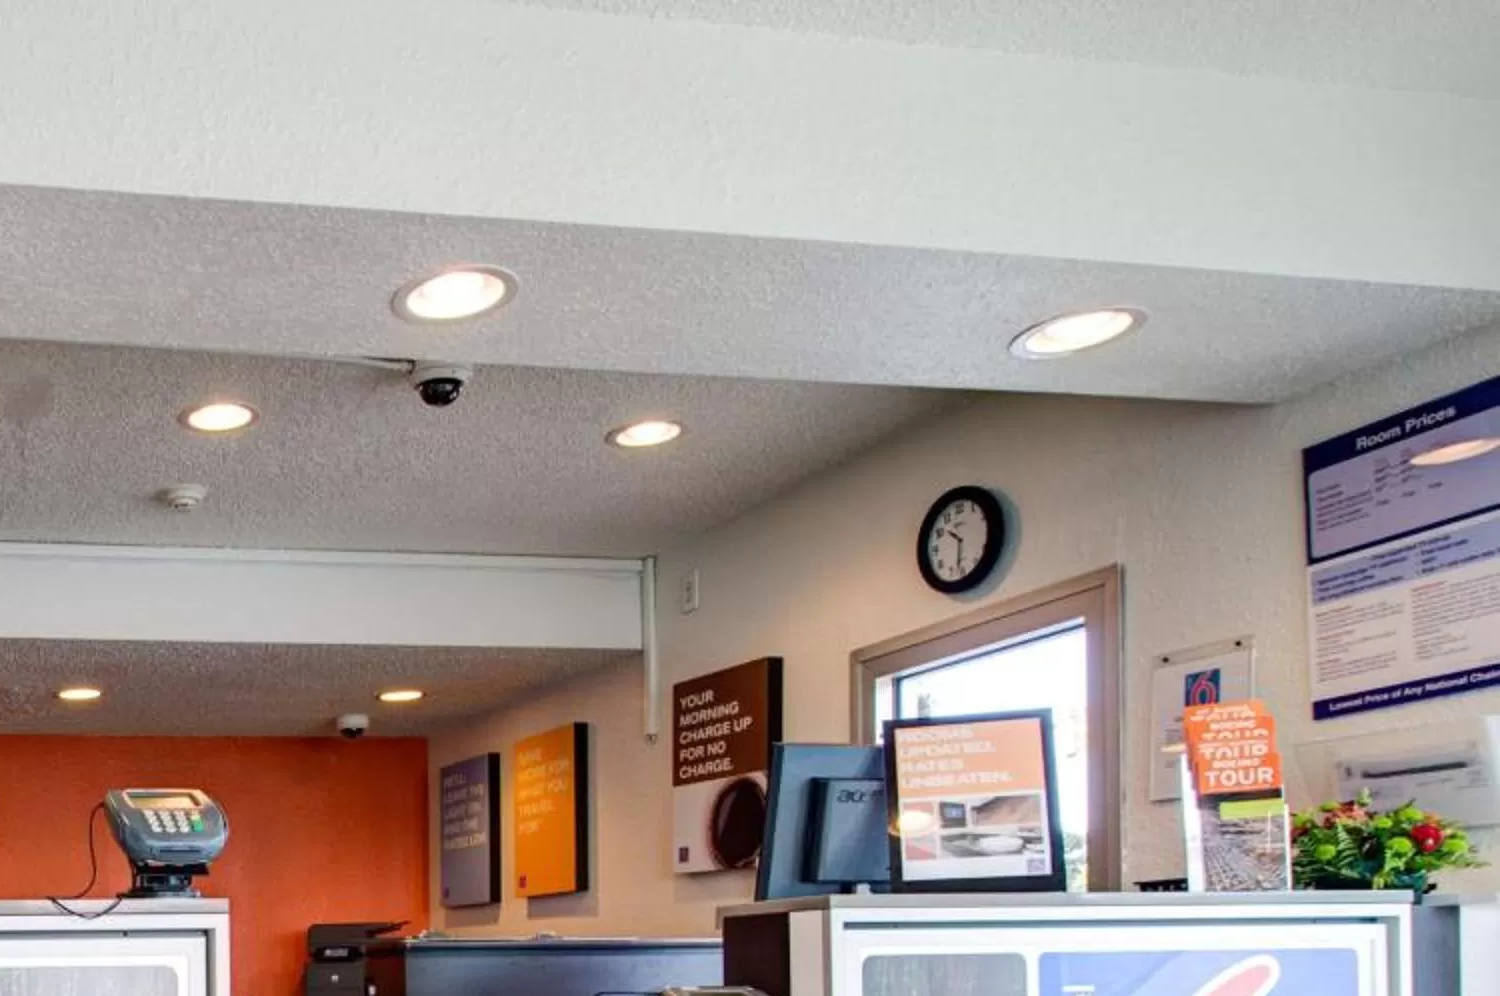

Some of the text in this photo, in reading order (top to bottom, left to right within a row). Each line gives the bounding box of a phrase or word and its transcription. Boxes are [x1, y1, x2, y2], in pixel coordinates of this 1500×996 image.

[1355, 406, 1457, 451] Room Prices
[679, 689, 714, 709] YOUR
[679, 701, 739, 727] MORNING
[679, 716, 753, 745] CHARGE UP
[680, 741, 727, 762] FOR NO
[679, 757, 734, 780] CHARGE.
[1204, 767, 1275, 787] TOUR
